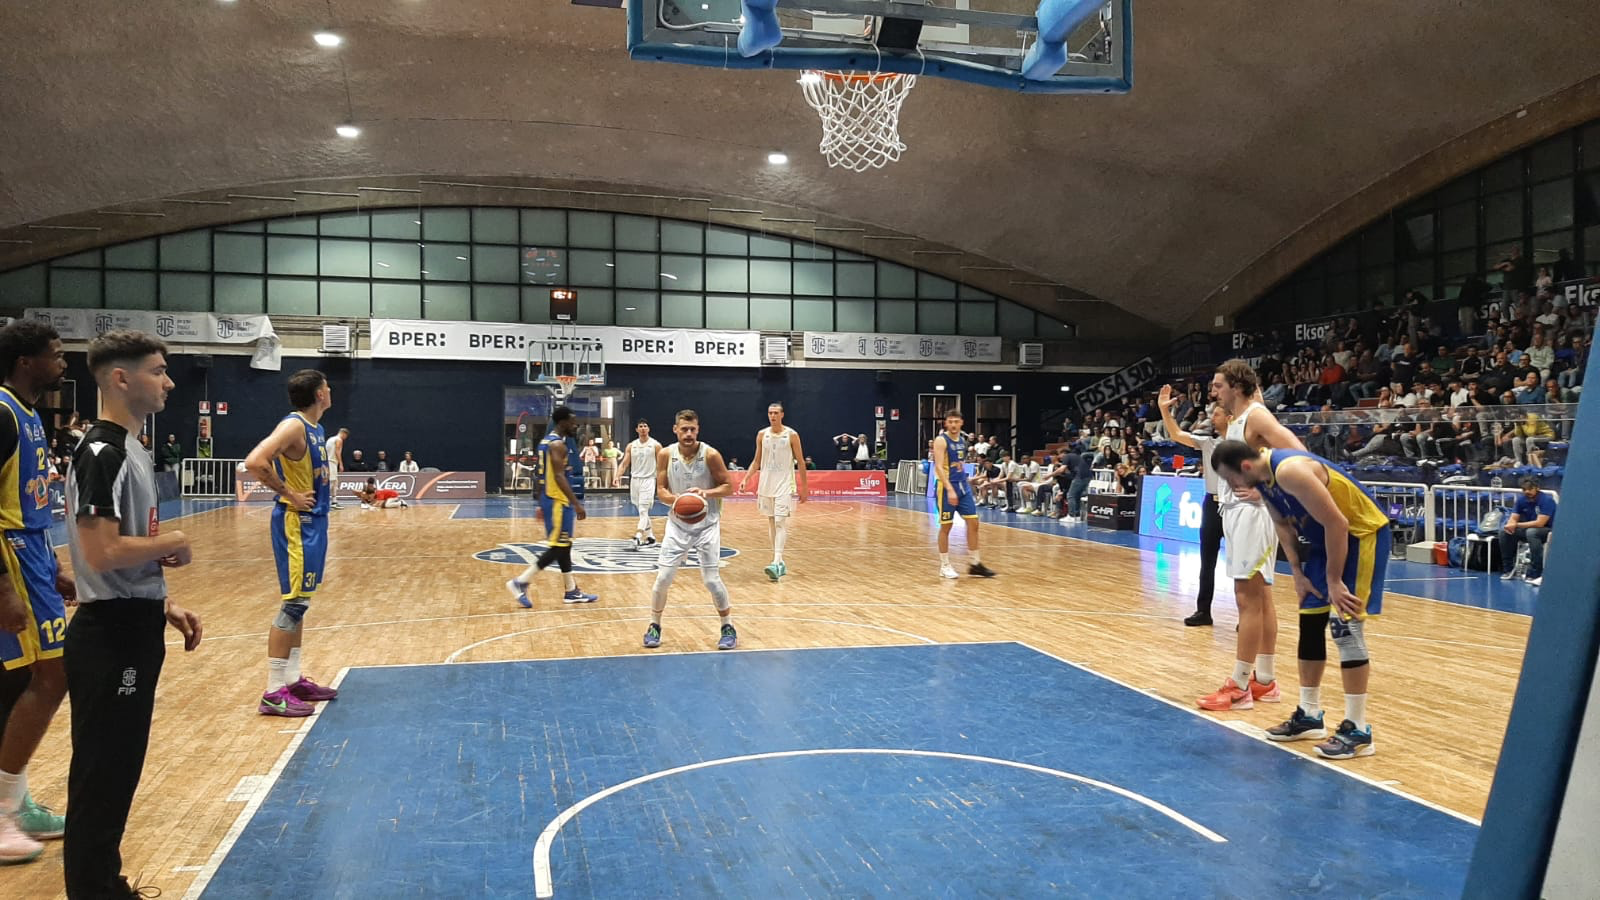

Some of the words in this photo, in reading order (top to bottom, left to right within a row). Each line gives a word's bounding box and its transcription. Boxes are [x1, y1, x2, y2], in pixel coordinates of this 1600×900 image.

[1295, 323, 1330, 341] Ekso
[1077, 374, 1131, 414] FOSSA
[340, 480, 407, 491] PRIMVERA
[305, 572, 316, 588] 31
[41, 617, 66, 644] 12
[118, 686, 136, 695] FIP
